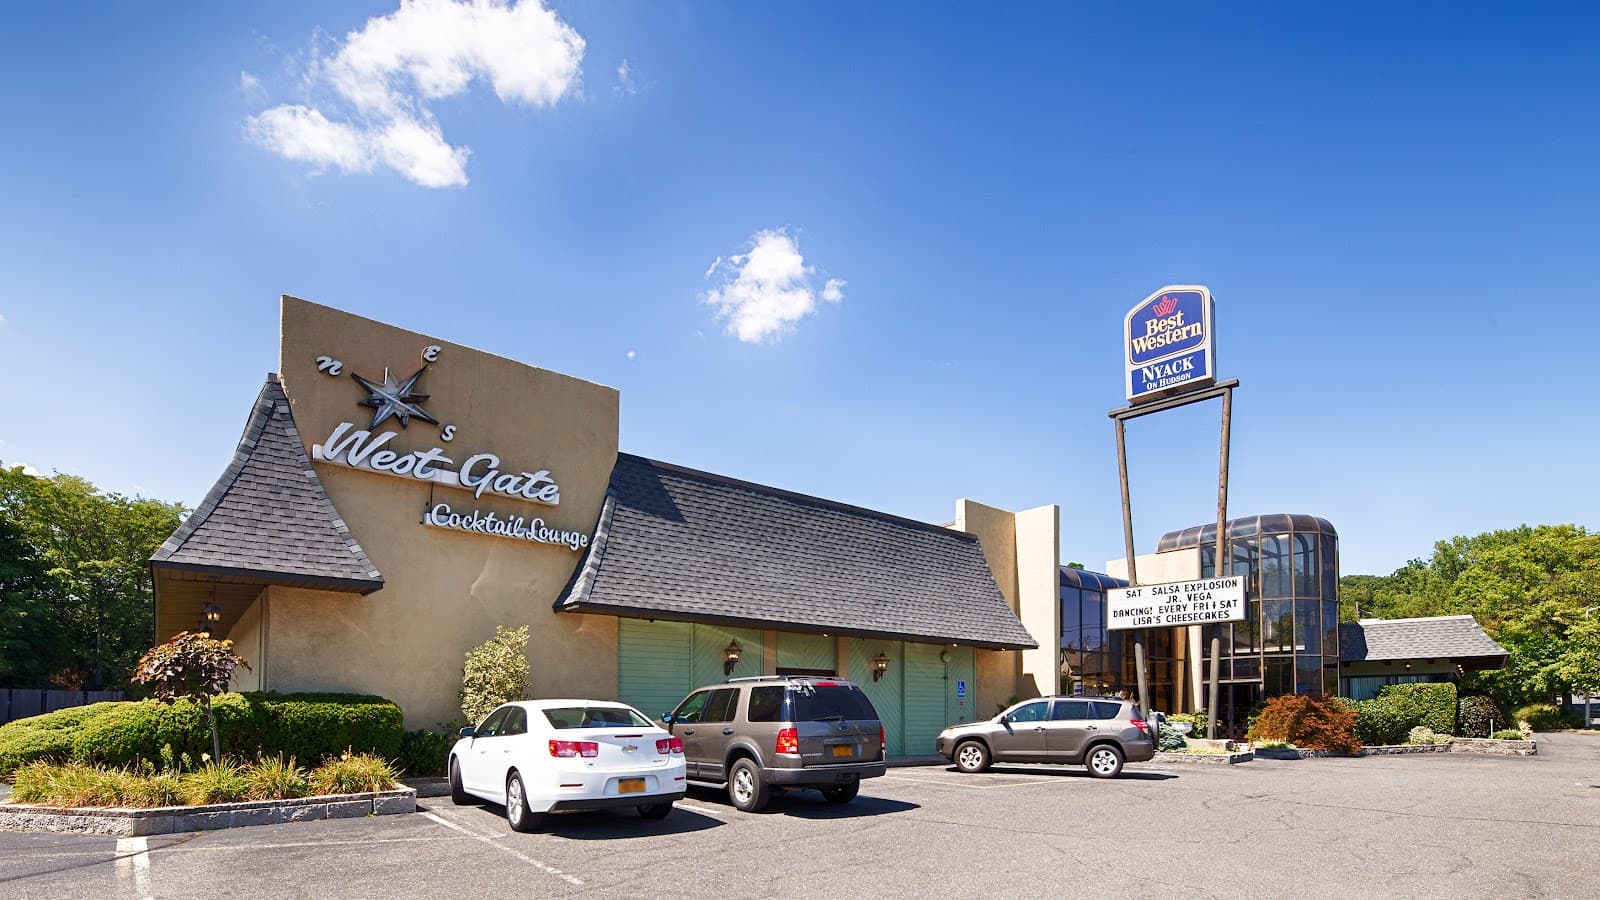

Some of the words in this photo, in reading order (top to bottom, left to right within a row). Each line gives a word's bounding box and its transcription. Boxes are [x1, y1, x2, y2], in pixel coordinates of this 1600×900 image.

[1145, 310, 1184, 337] Best
[1131, 322, 1202, 355] Western
[322, 422, 453, 479] West
[459, 453, 560, 502] Gate
[431, 503, 528, 538] Cocktail
[525, 518, 588, 551] Lounge
[1126, 589, 1142, 598] SAT
[1152, 585, 1180, 595] SALSA
[1184, 579, 1238, 592] EXPLOSION
[1166, 595, 1182, 603] JR.
[1187, 592, 1212, 601] VEGA
[1113, 607, 1153, 618] DANCING!
[1159, 603, 1188, 614] EVERY
[1193, 601, 1209, 611] FRI
[1219, 599, 1238, 609] SAT
[1133, 616, 1161, 625] LISA'S
[1166, 610, 1230, 623] CHEESECAKES
